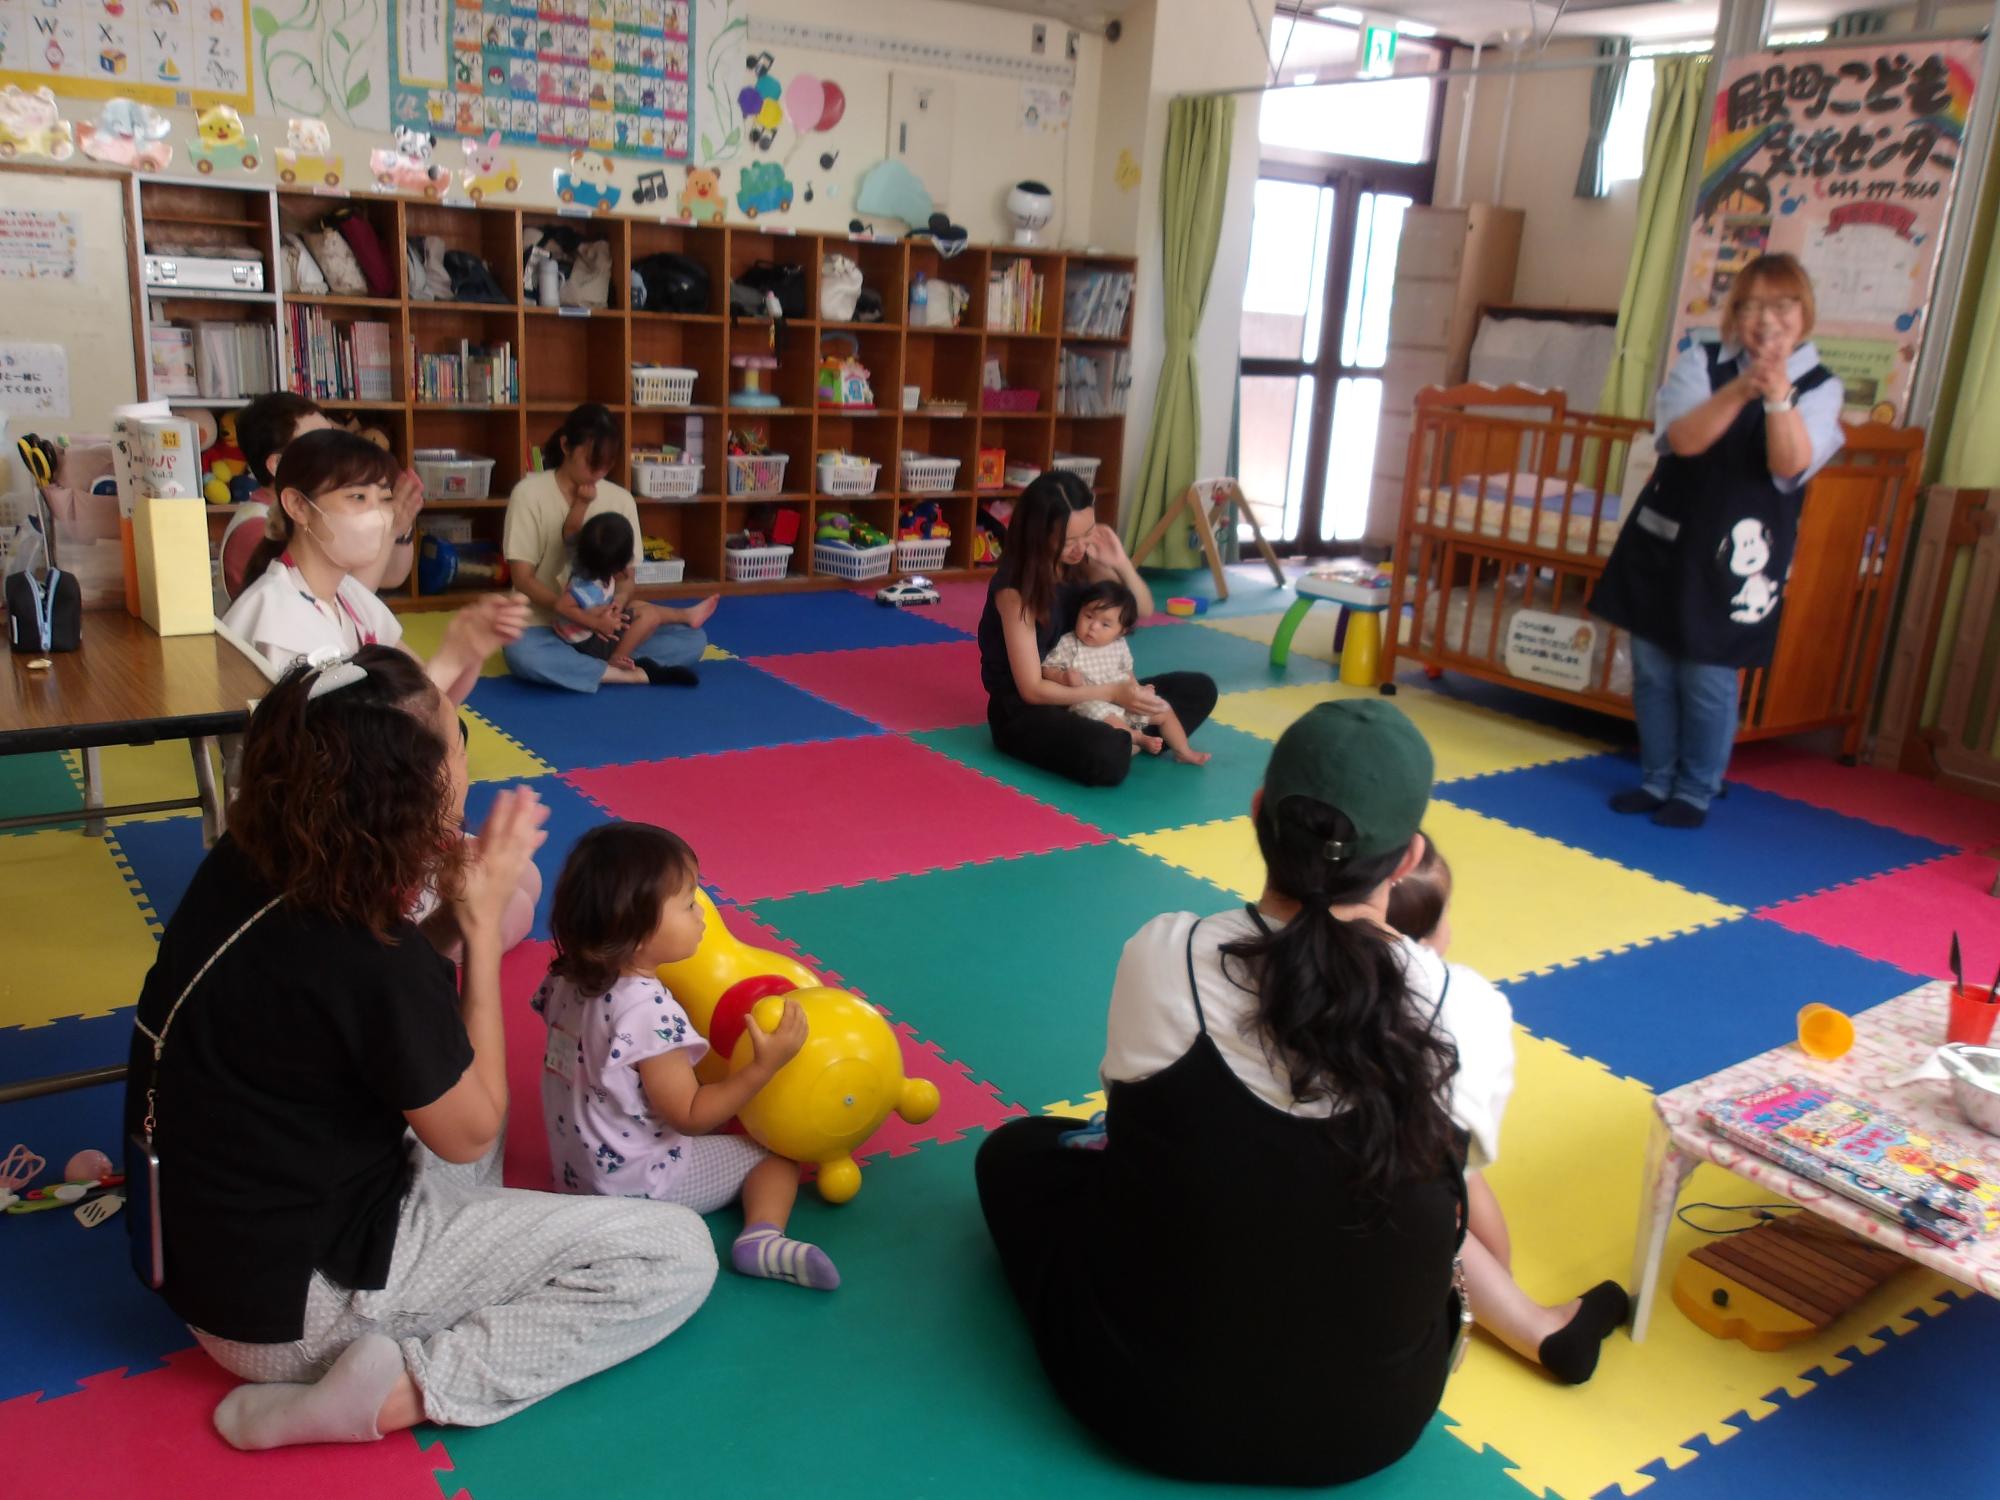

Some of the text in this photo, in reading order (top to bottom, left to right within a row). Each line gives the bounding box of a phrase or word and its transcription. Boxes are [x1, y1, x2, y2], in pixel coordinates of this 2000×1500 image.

[33, 16, 59, 35] W
[98, 22, 114, 43] X
[153, 29, 167, 49] Y
[208, 36, 221, 57] Z
[1762, 122, 1956, 180] 文化センター
[0, 372, 42, 382] と一緒に
